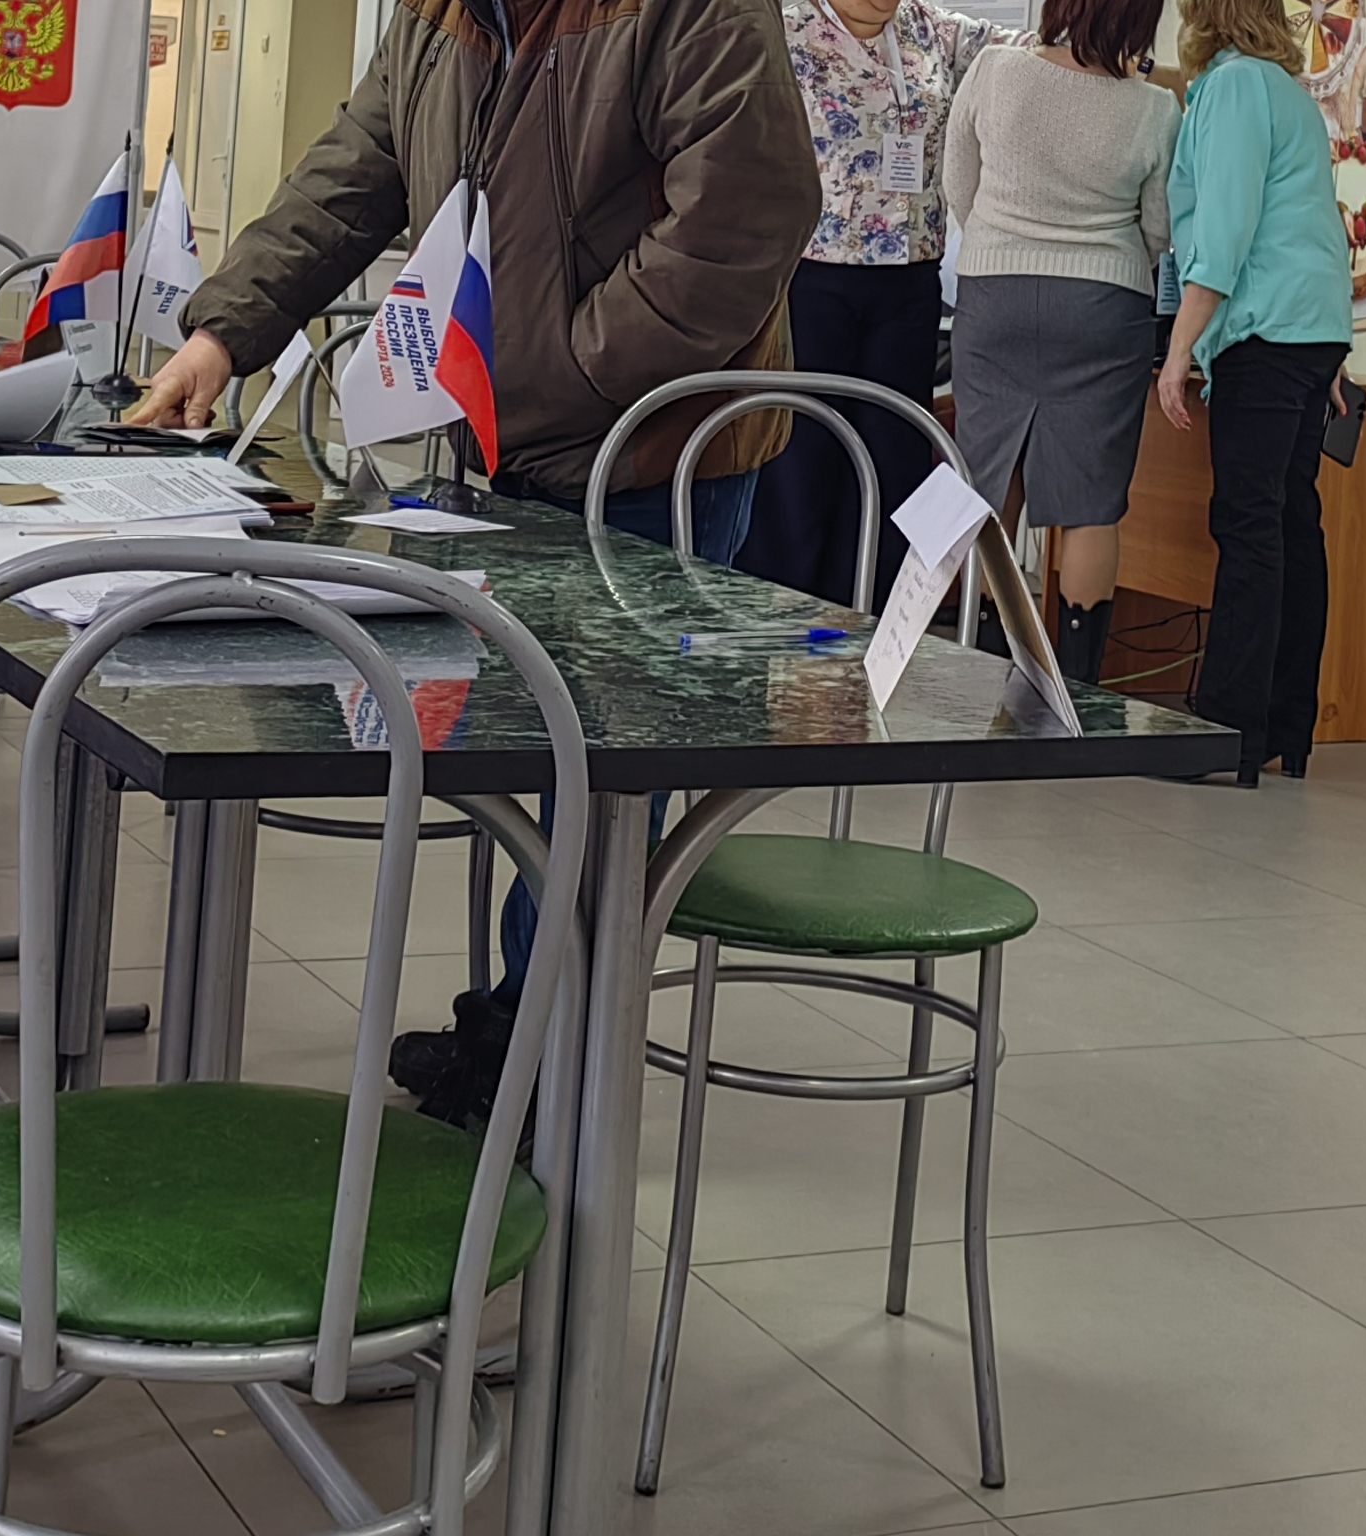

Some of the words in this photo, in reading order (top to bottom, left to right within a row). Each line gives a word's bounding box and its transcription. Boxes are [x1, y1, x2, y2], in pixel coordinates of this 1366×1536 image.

[375, 329, 389, 362] МАРТА
[385, 303, 404, 357] РОССИИ
[399, 305, 430, 392] ПРЕЗИДЕНТА
[416, 307, 439, 368] ВЫБОРЫ
